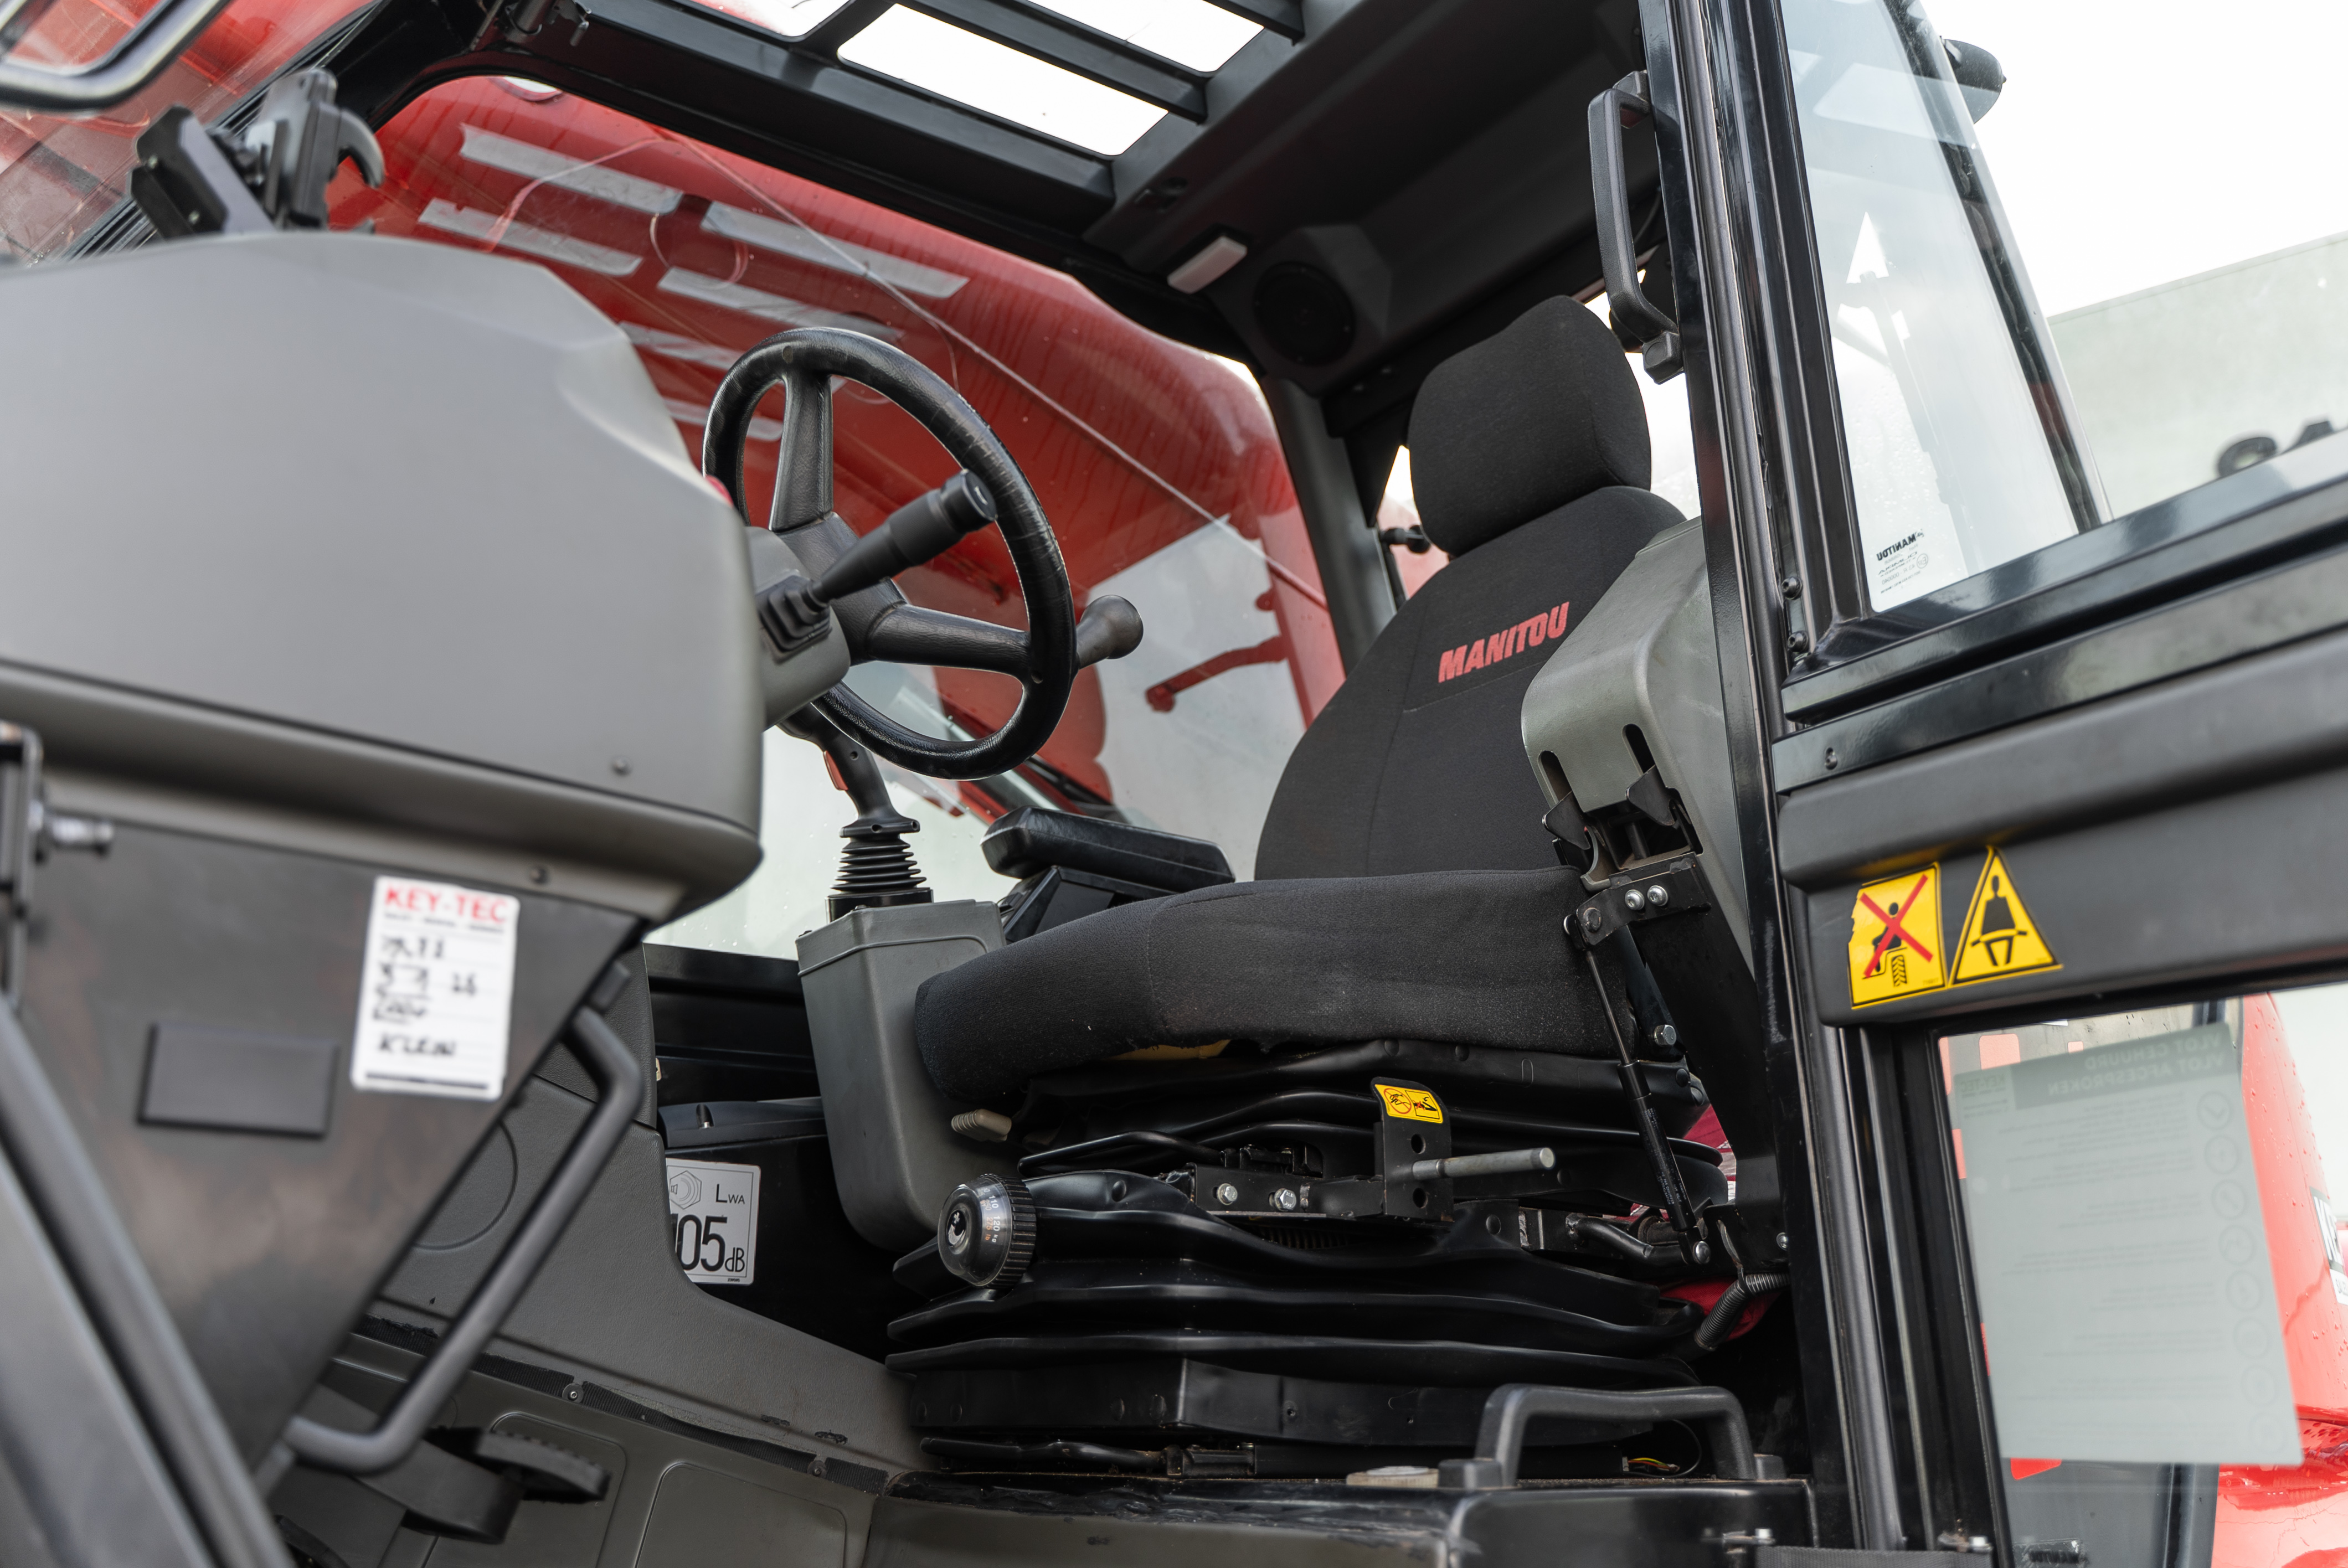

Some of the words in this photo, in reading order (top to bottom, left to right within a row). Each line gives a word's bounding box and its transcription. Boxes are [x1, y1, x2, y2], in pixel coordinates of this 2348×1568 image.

[1438, 601, 1569, 683] MANITOU
[384, 885, 508, 923] KEY-TEC
[988, 1195, 999, 1209] 110
[724, 1247, 745, 1272] dB
